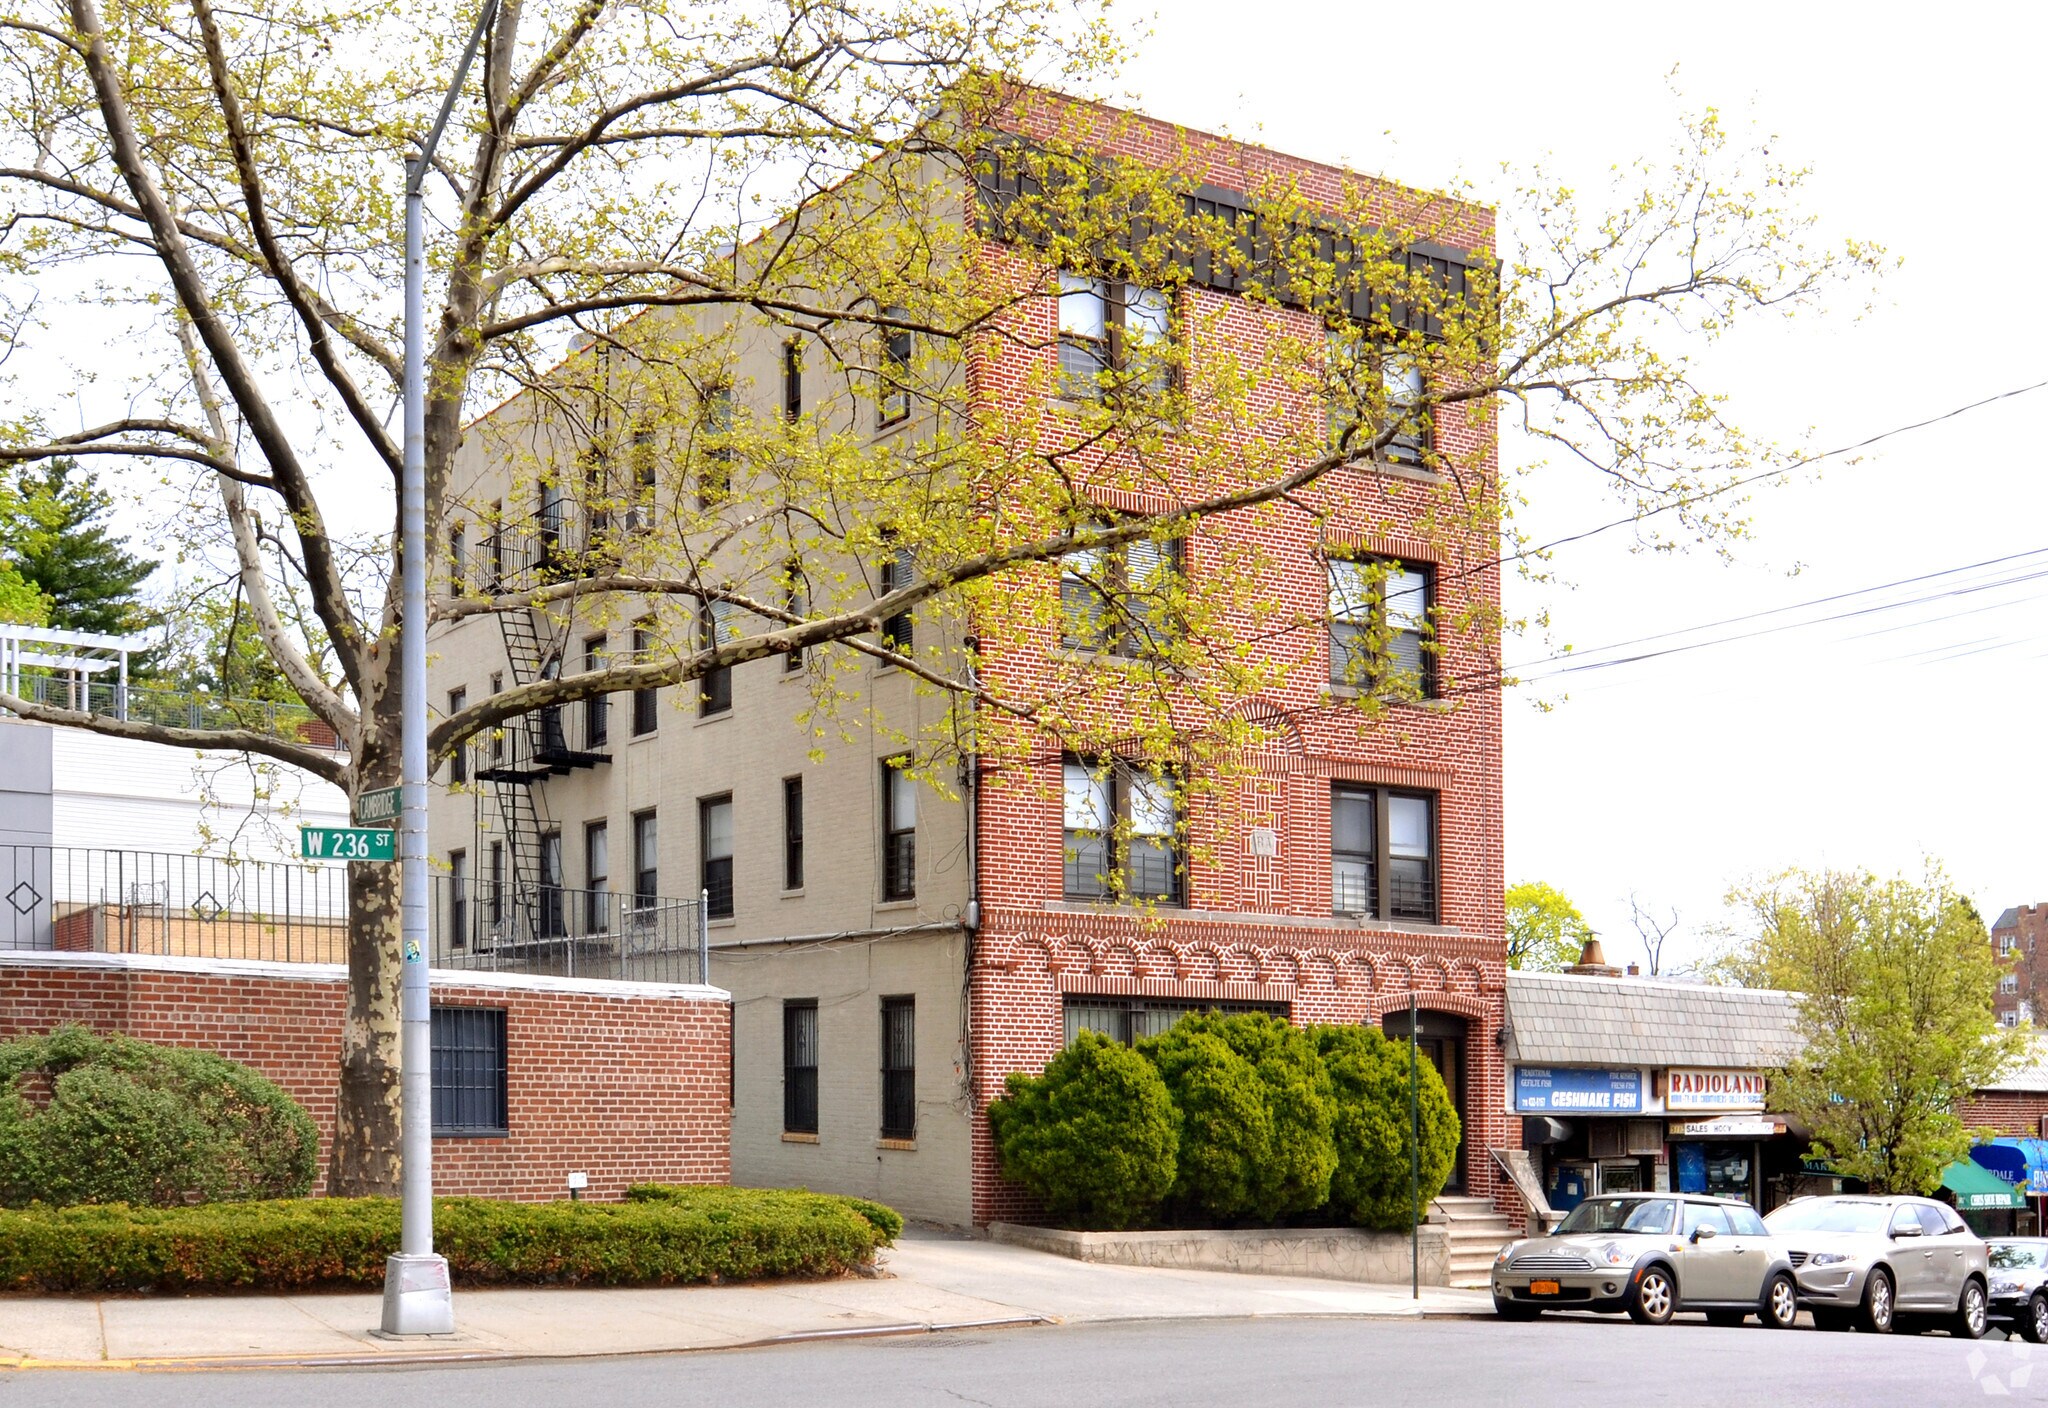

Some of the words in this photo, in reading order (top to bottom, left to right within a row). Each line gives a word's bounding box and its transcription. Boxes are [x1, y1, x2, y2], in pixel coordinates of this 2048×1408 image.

[360, 790, 395, 819] CAMBRIDGE
[307, 831, 324, 856] W
[332, 833, 369, 857] 236
[375, 833, 390, 847] ST
[1671, 1073, 1763, 1093] RADIOLAND
[1551, 1091, 1610, 1108] GESHMAKE
[1613, 1092, 1637, 1108] FISH
[1686, 1125, 1708, 1133] SALES
